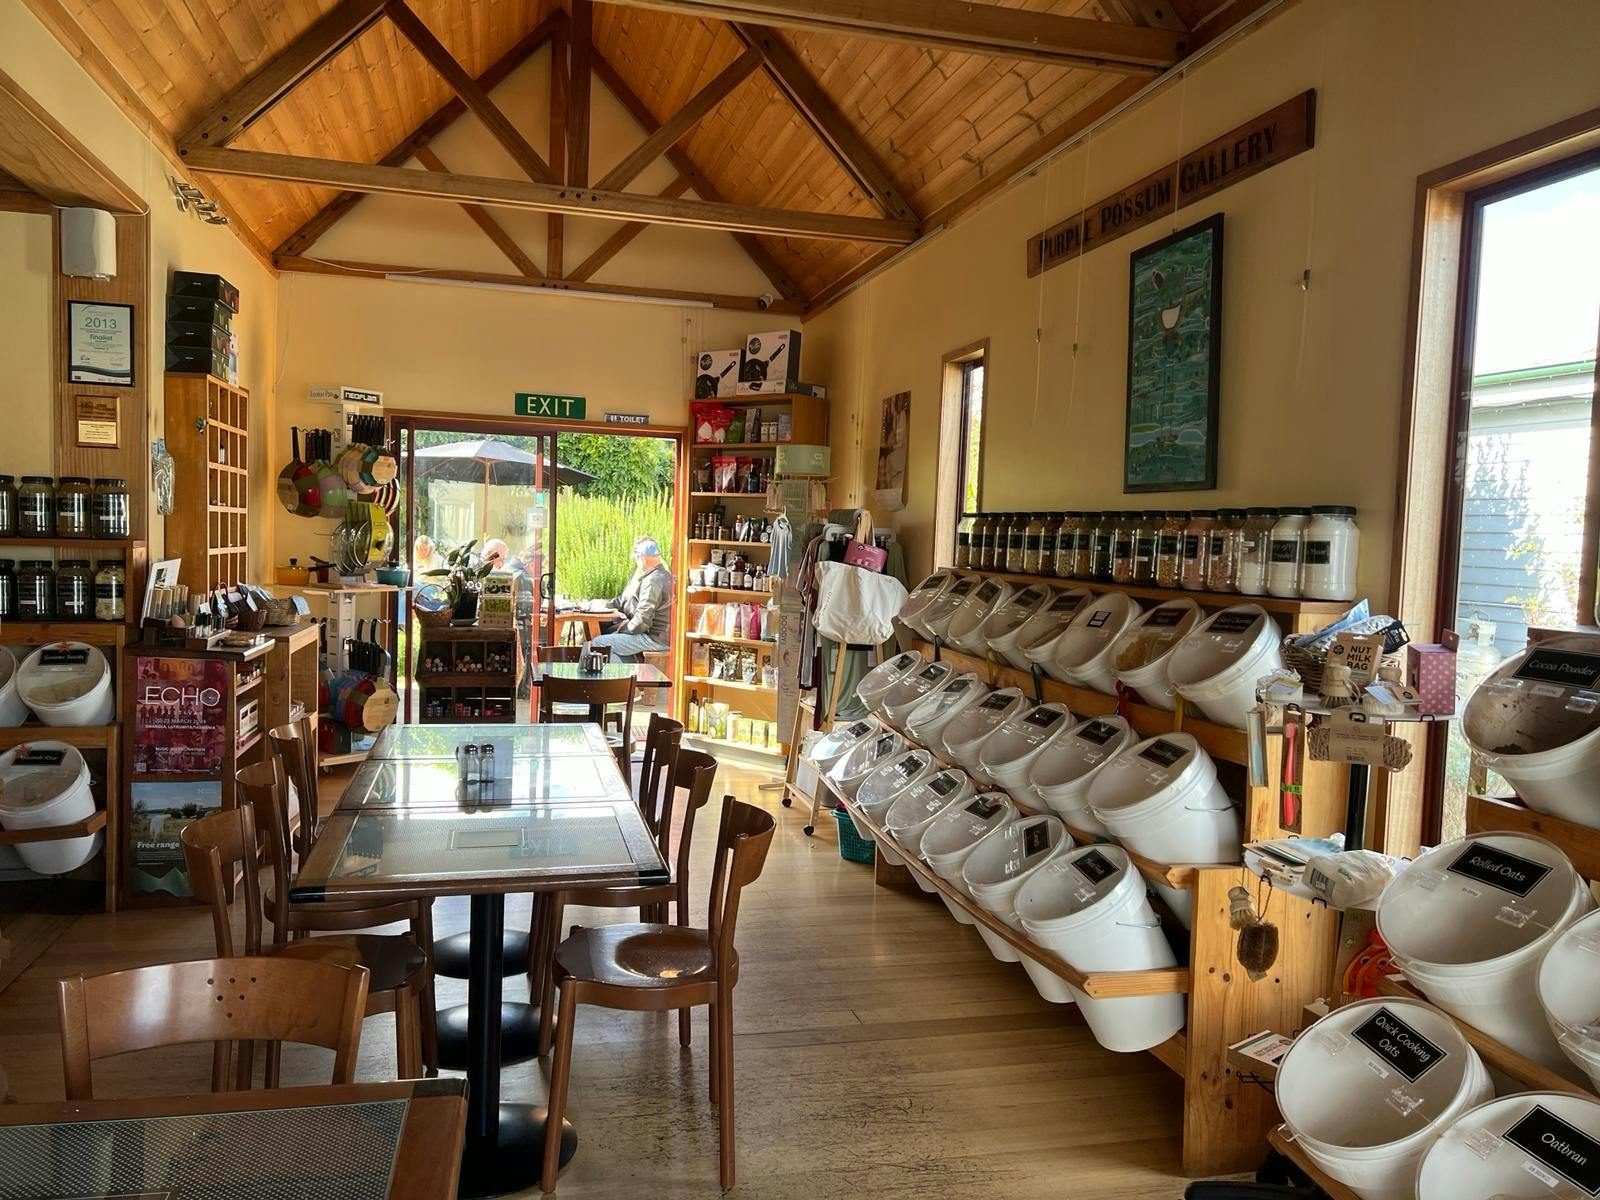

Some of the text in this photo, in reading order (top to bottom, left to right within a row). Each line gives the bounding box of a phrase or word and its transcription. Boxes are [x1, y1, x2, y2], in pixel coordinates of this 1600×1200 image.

[1039, 122, 1277, 265] PURPLE POSSUM GALLERY
[85, 317, 117, 329] 2013
[527, 397, 575, 417] EXIT
[620, 415, 646, 424] TOILET
[1346, 653, 1372, 662] MILK
[1350, 645, 1372, 654] NUT
[1346, 661, 1368, 670] BAG
[1528, 659, 1598, 677] Cocoa Powder
[144, 686, 220, 706] ECHO
[137, 841, 180, 850] Free range
[1469, 856, 1526, 882] Rolled Oats
[1375, 1016, 1431, 1063] Quick Cooking
[1378, 1038, 1400, 1058] Oats
[1541, 1132, 1588, 1166] Oatbran
